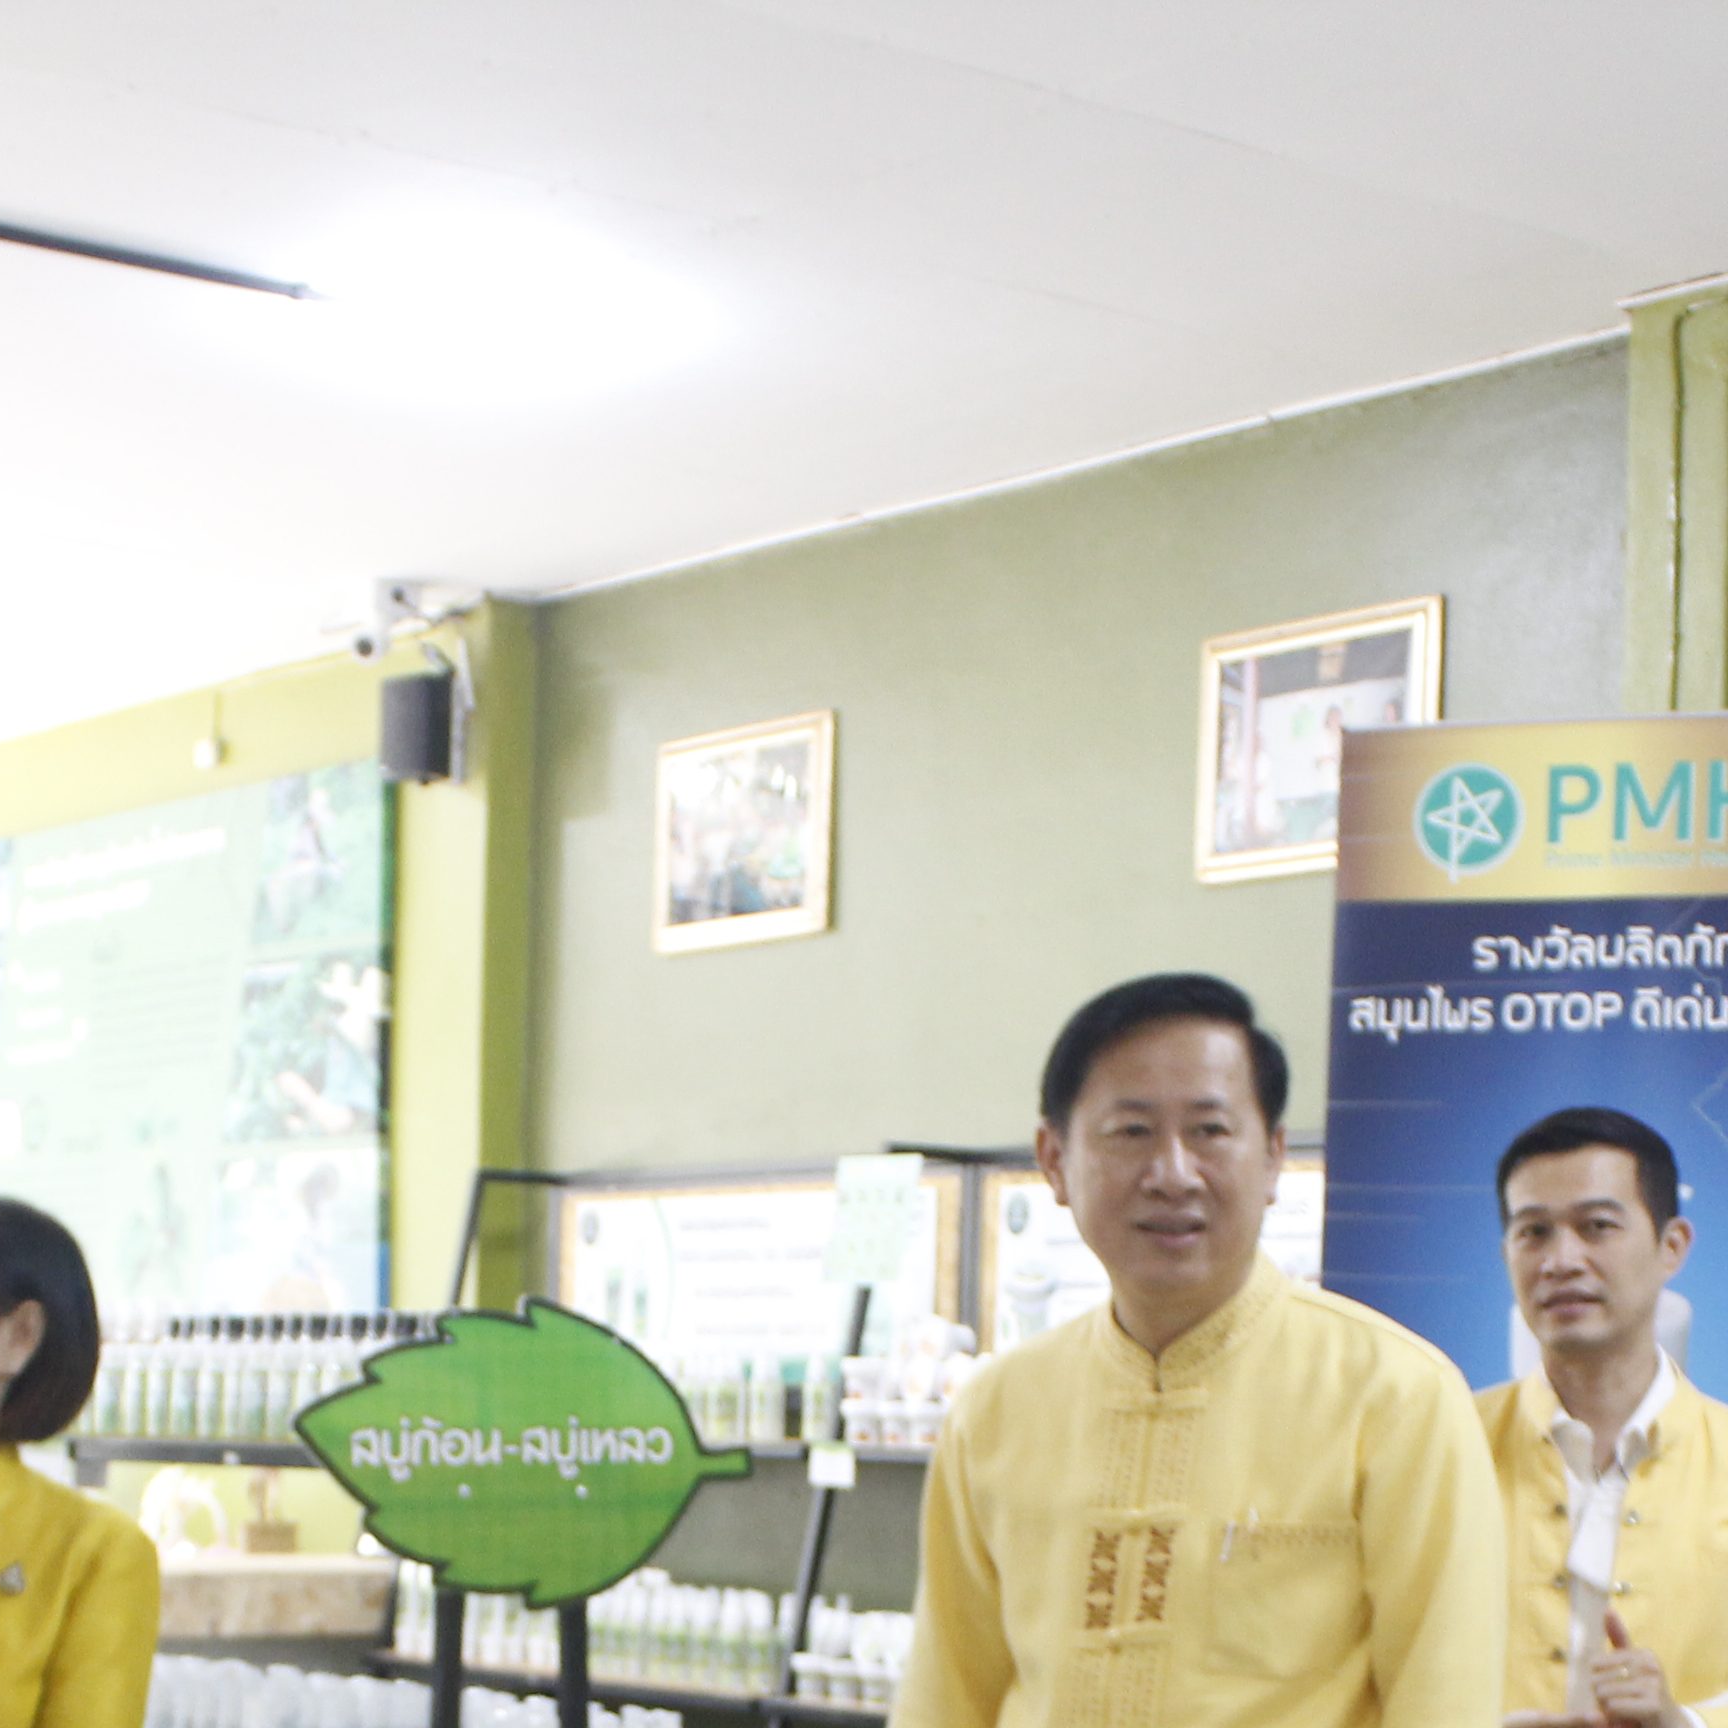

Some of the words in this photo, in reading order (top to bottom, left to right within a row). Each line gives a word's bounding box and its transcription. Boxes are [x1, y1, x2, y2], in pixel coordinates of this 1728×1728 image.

[1348, 985, 1494, 1043] สมุนไพร
[1501, 991, 1625, 1033] OTOP
[350, 1416, 673, 1482] สบู่ก้อน-สบู่เหลว
